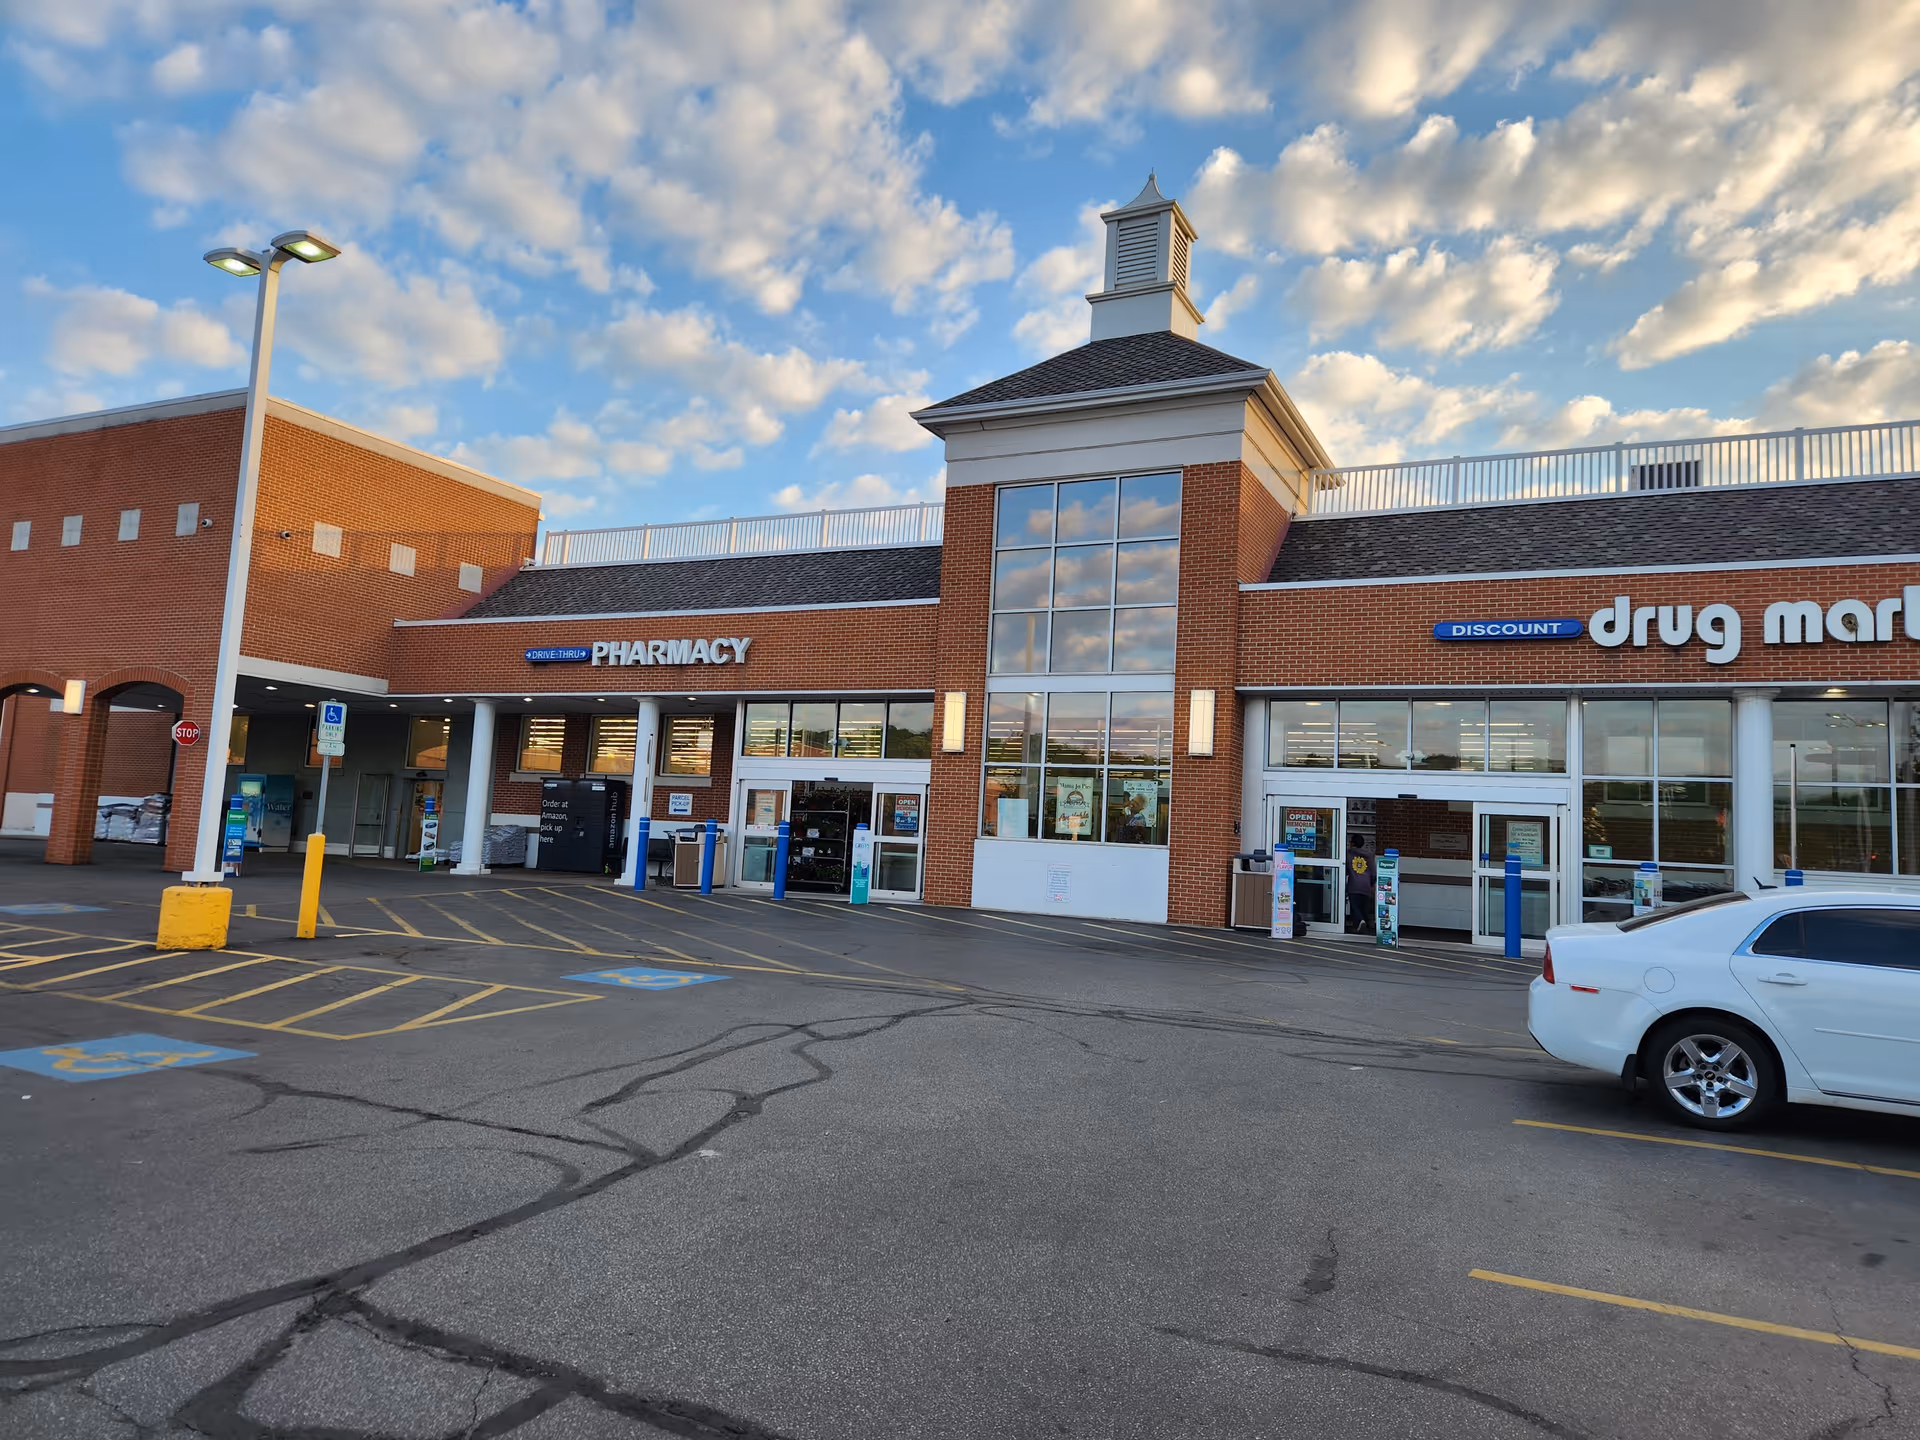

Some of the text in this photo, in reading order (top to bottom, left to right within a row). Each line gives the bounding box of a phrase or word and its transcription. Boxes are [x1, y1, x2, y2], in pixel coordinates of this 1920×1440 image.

[1451, 622, 1562, 638] DISCOUNT
[1588, 595, 1742, 665] drug
[532, 637, 752, 666] DRIVE-THRU PHARMACY
[176, 727, 199, 739] STOP
[267, 803, 292, 811] Water
[542, 800, 560, 808] Order
[541, 812, 568, 821] Amazon,
[609, 791, 618, 849] amazon hub
[1289, 813, 1313, 821] OPEN
[540, 824, 563, 833] pick up
[540, 835, 554, 844] here
